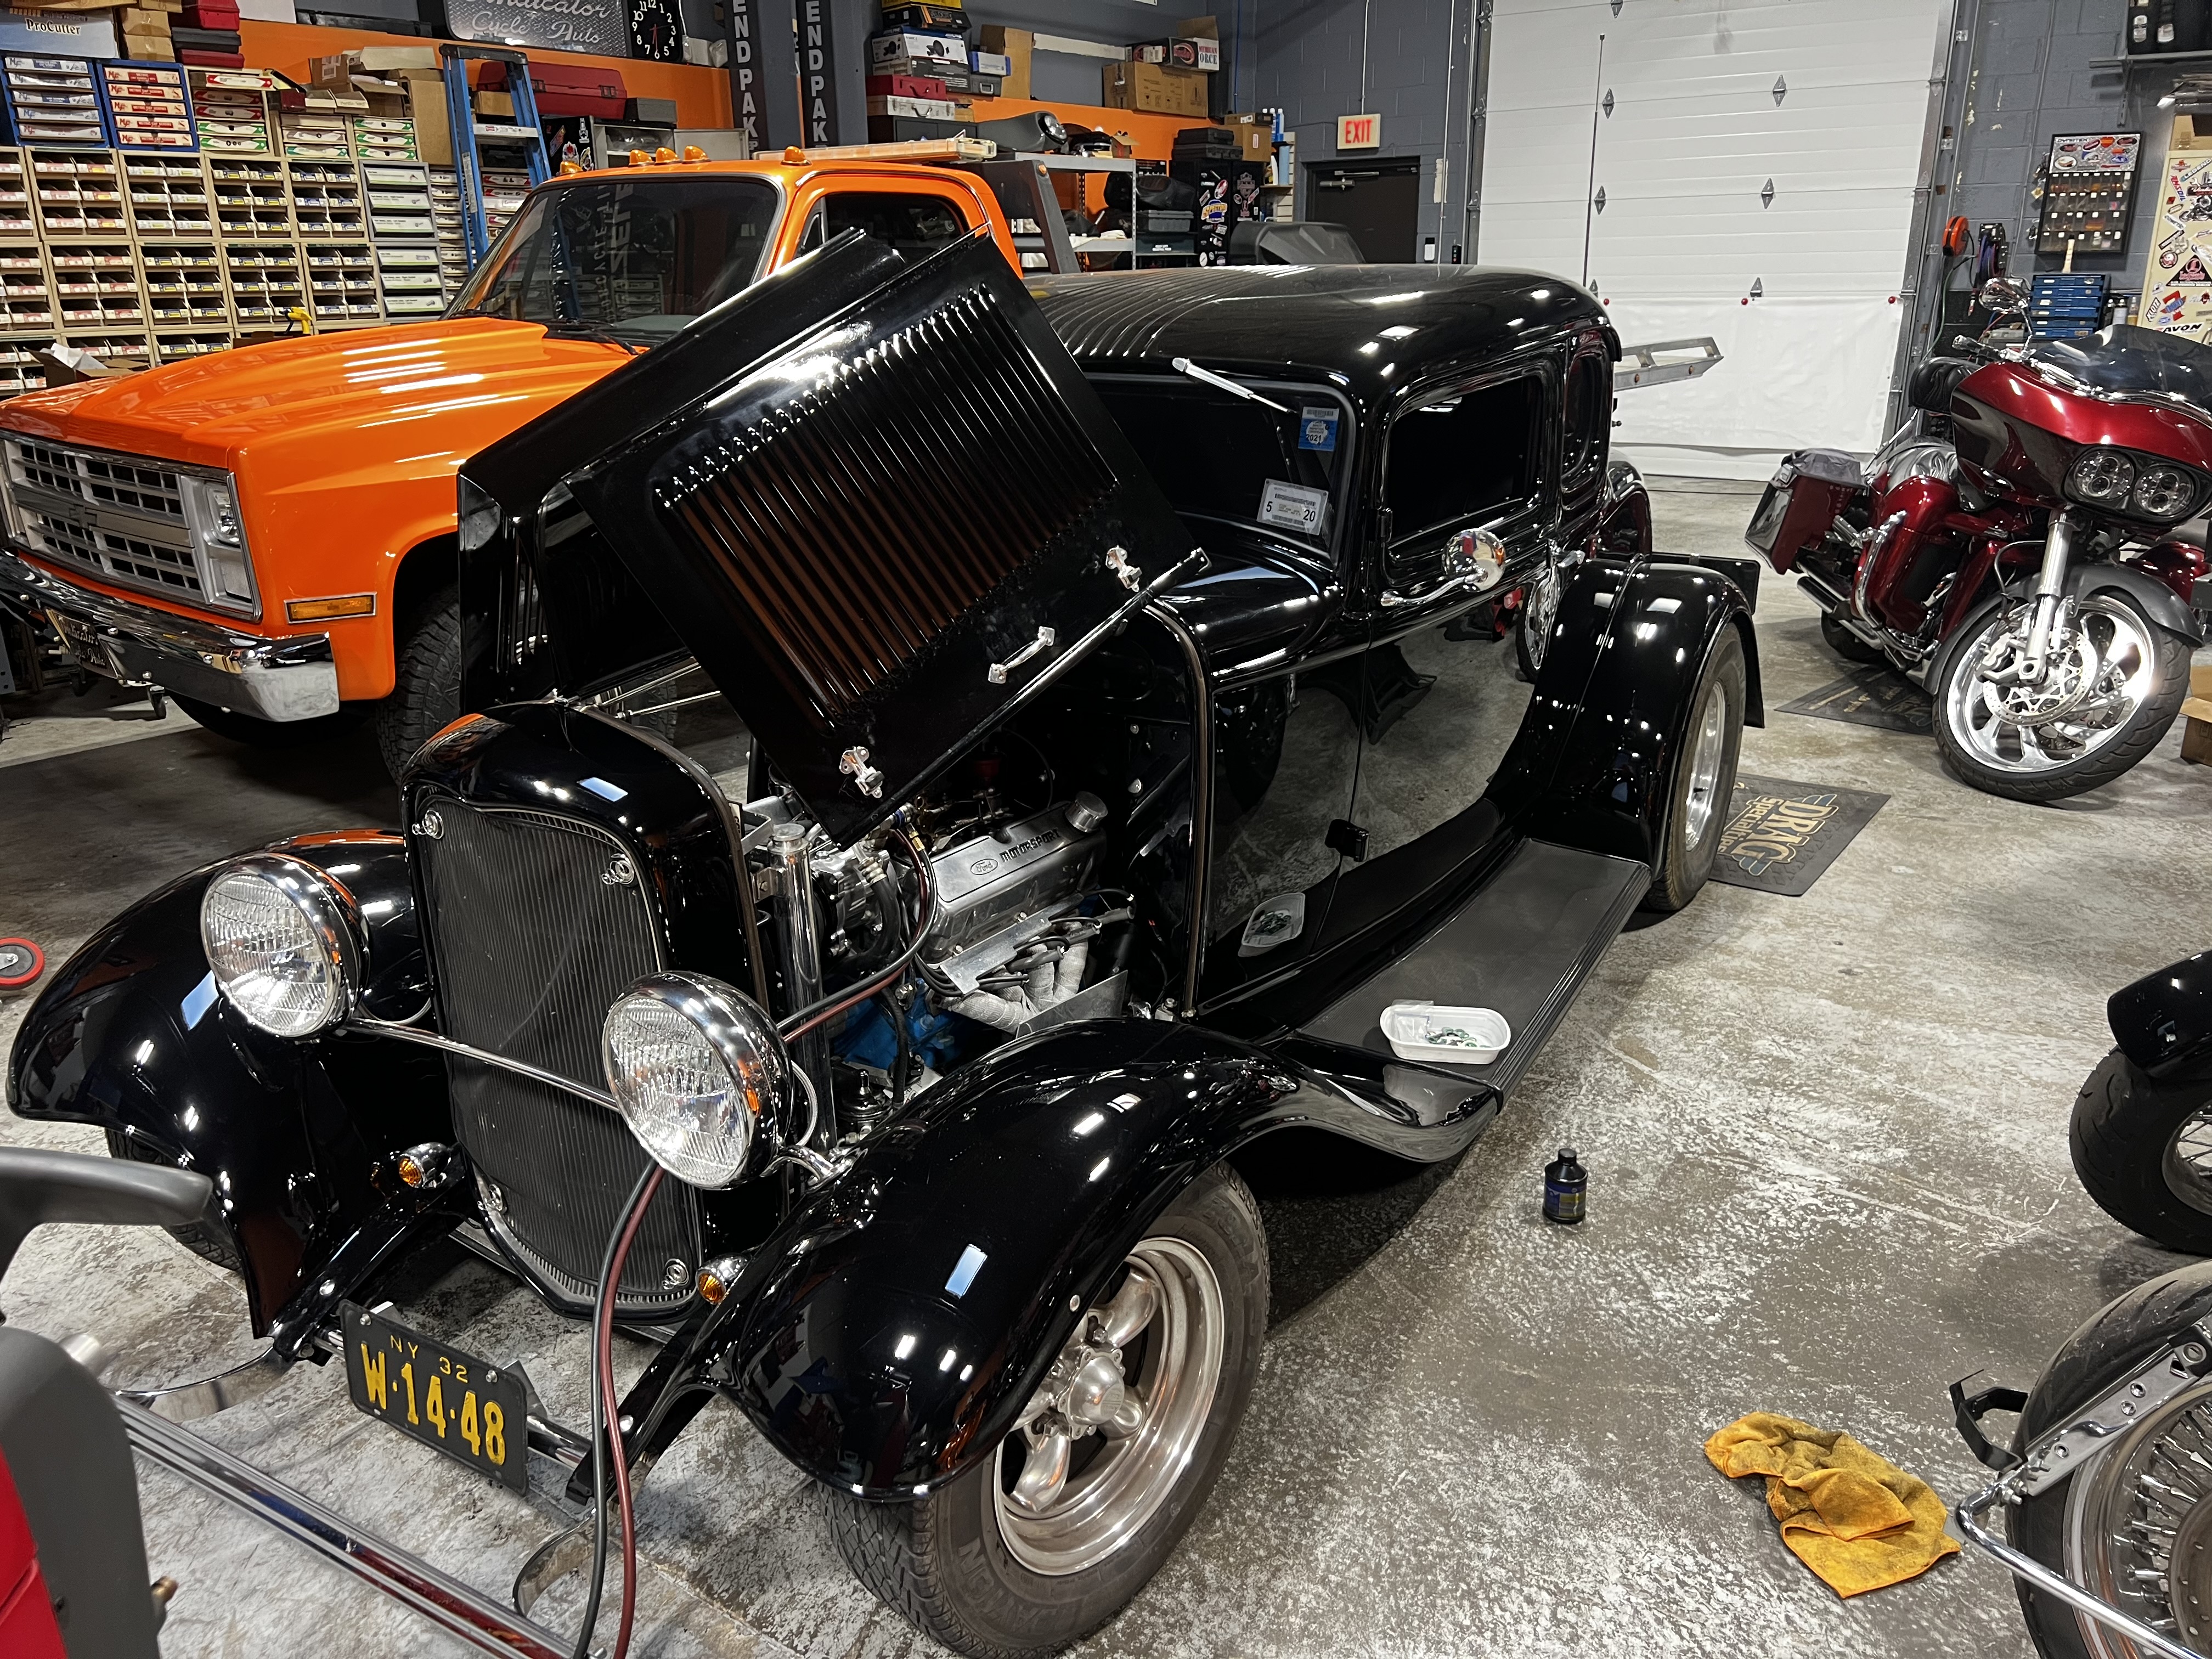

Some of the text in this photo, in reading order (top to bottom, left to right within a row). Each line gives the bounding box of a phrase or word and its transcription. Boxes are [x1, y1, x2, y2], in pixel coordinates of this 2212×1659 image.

[639, 1, 647, 12] 11
[648, 0, 656, 8] 12
[659, 3, 664, 13] 1
[633, 10, 644, 21] 10
[667, 13, 672, 22] 2
[26, 18, 81, 35] ProCutter
[472, 12, 529, 35] Cycle
[546, 21, 604, 42] Auto
[632, 21, 637, 31] 9
[671, 25, 676, 35] 3
[637, 35, 642, 44] 8
[669, 37, 675, 46] 4
[645, 44, 650, 54] 7
[654, 49, 660, 59] 6
[664, 46, 669, 56] 5
[1200, 53, 1217, 65] ORCE
[1345, 119, 1373, 144] EXIT
[2184, 158, 2211, 179] LEGEND
[2146, 297, 2160, 320] KLOTZ
[2163, 323, 2203, 333] AVON
[1266, 501, 1273, 512] 5
[1303, 509, 1316, 522] 20
[999, 828, 1061, 862] MOTORSPORT
[977, 862, 993, 872] Ford
[390, 1334, 468, 1384] NY 32
